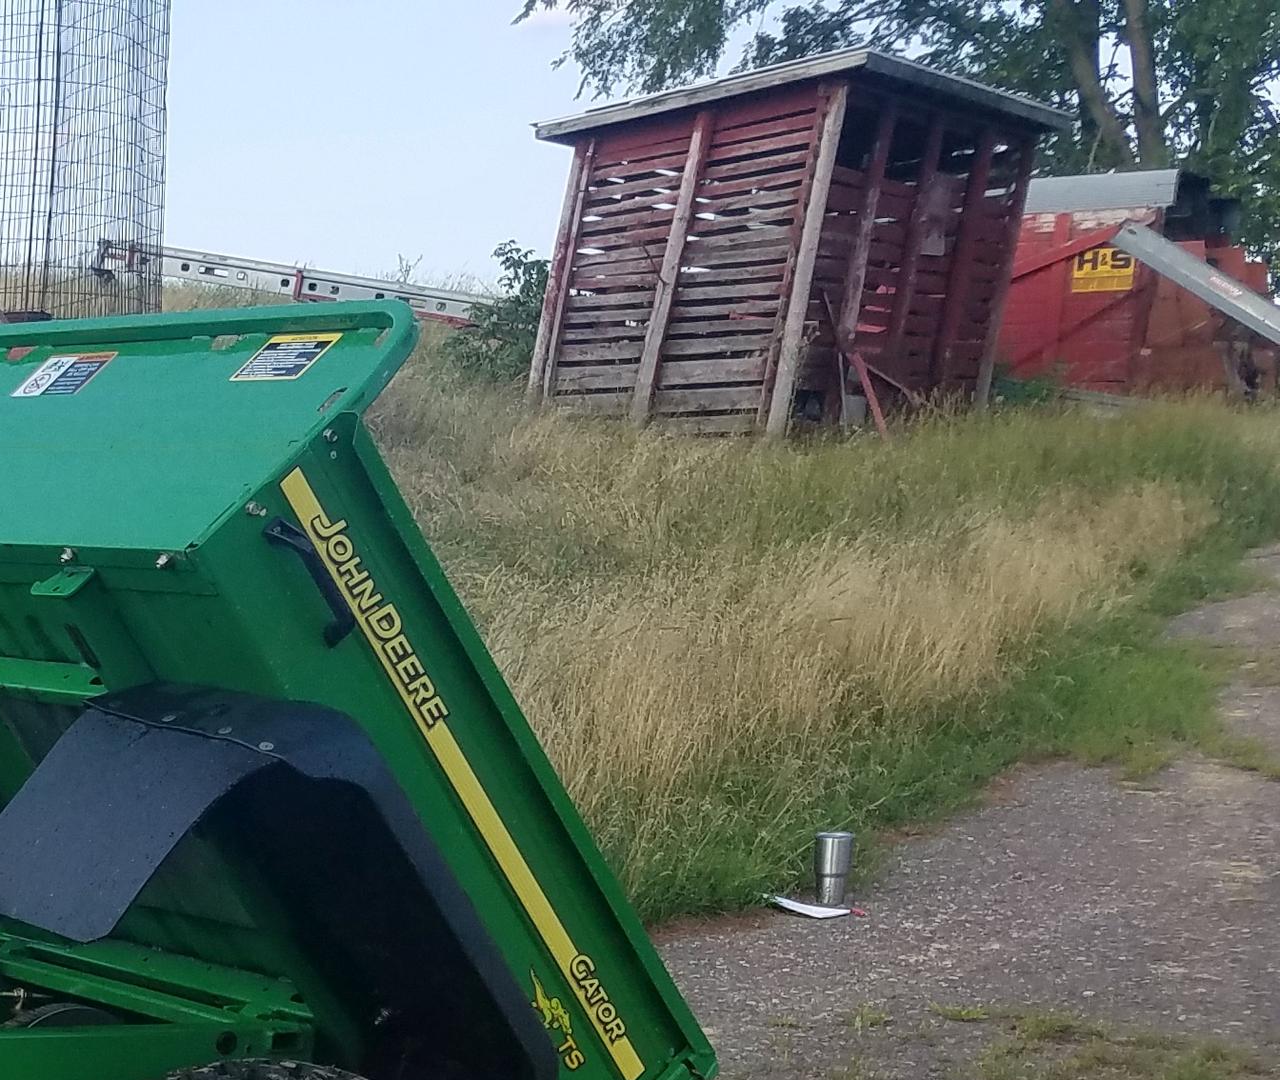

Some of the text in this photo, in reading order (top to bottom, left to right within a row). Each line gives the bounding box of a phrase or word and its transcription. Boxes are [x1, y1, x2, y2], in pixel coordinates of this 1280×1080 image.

[1076, 249, 1132, 272] H&S
[311, 514, 449, 730] JOHN DEERE
[570, 954, 626, 1045] GATOR
[558, 1034, 585, 1070] TS
